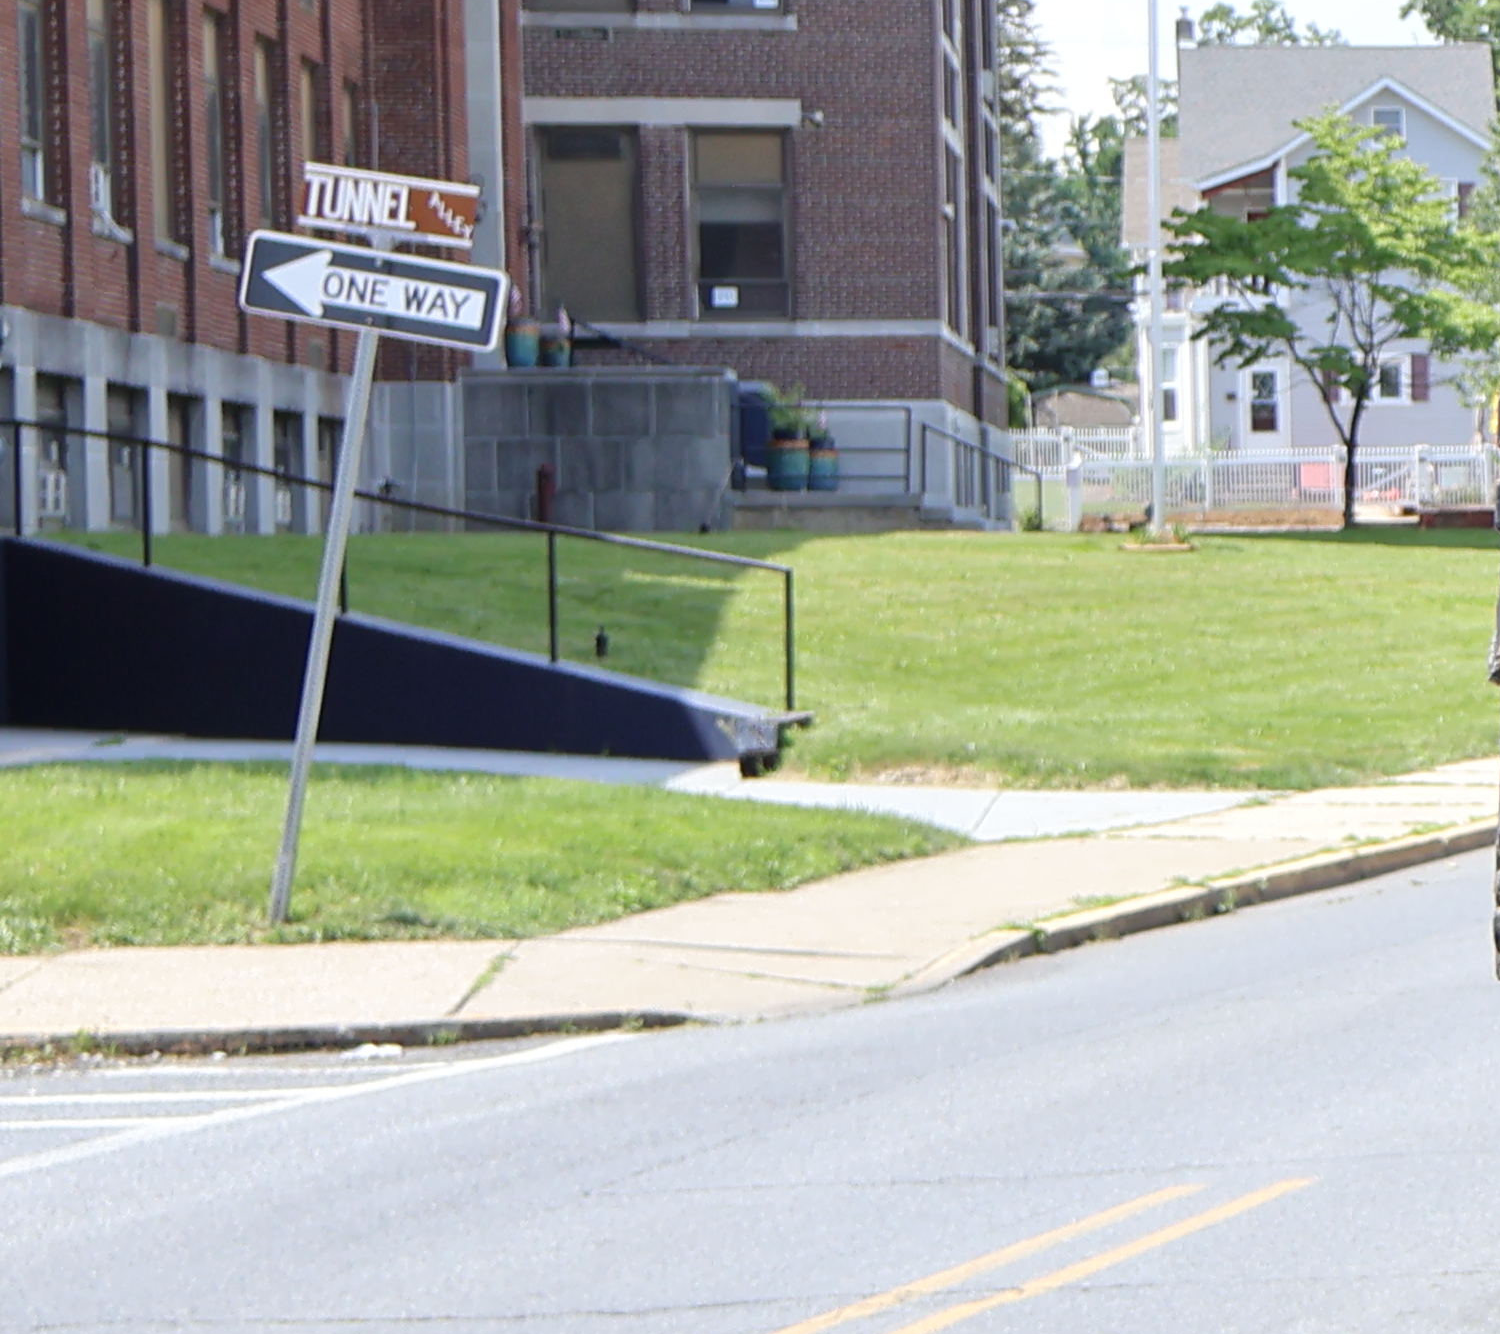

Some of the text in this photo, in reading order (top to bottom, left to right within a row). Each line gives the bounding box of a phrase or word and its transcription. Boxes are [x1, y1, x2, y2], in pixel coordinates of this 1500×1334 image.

[304, 173, 415, 226] TUNNEL
[427, 190, 474, 240] ALLEY
[322, 271, 470, 321] ONE WAY
